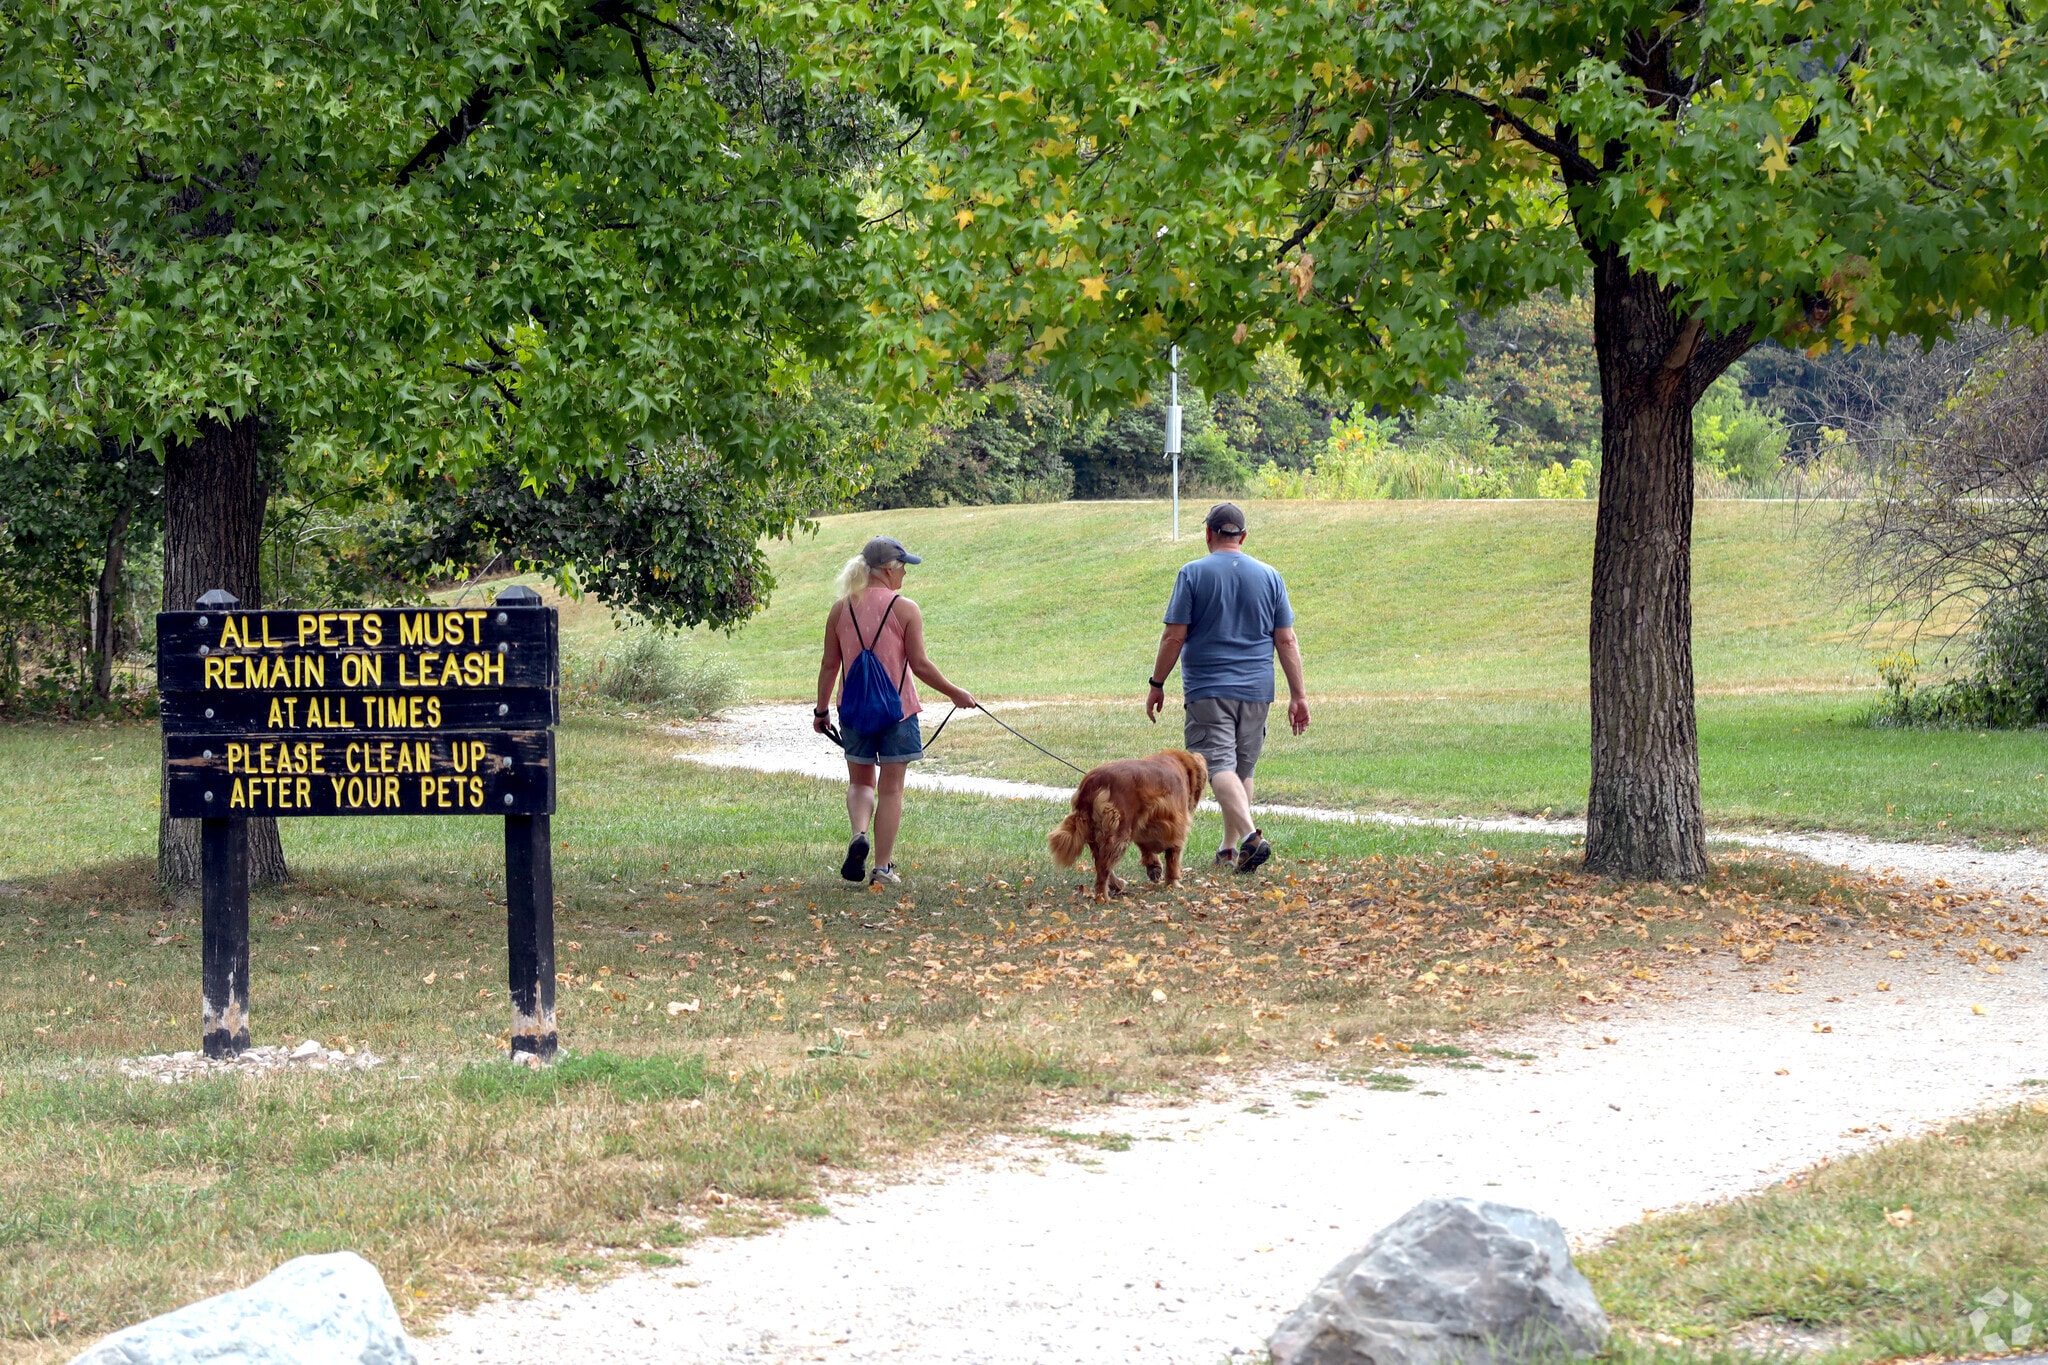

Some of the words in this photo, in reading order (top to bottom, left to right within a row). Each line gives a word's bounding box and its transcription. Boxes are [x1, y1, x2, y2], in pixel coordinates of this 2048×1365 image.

[219, 615, 282, 648] ALL
[297, 613, 383, 647] PETS
[399, 610, 487, 645] MUST
[204, 654, 325, 689] REMAIN
[341, 653, 382, 687] ON
[398, 652, 505, 686] LEASH
[267, 696, 298, 728] AT
[306, 696, 355, 728] ALL
[362, 696, 442, 728] TIMES
[227, 742, 326, 774] PLEASE
[345, 741, 431, 773] CLEAN
[452, 740, 487, 773] UP
[230, 776, 312, 808] AFTER
[331, 776, 401, 808] YOUR
[420, 775, 484, 807] PETS
